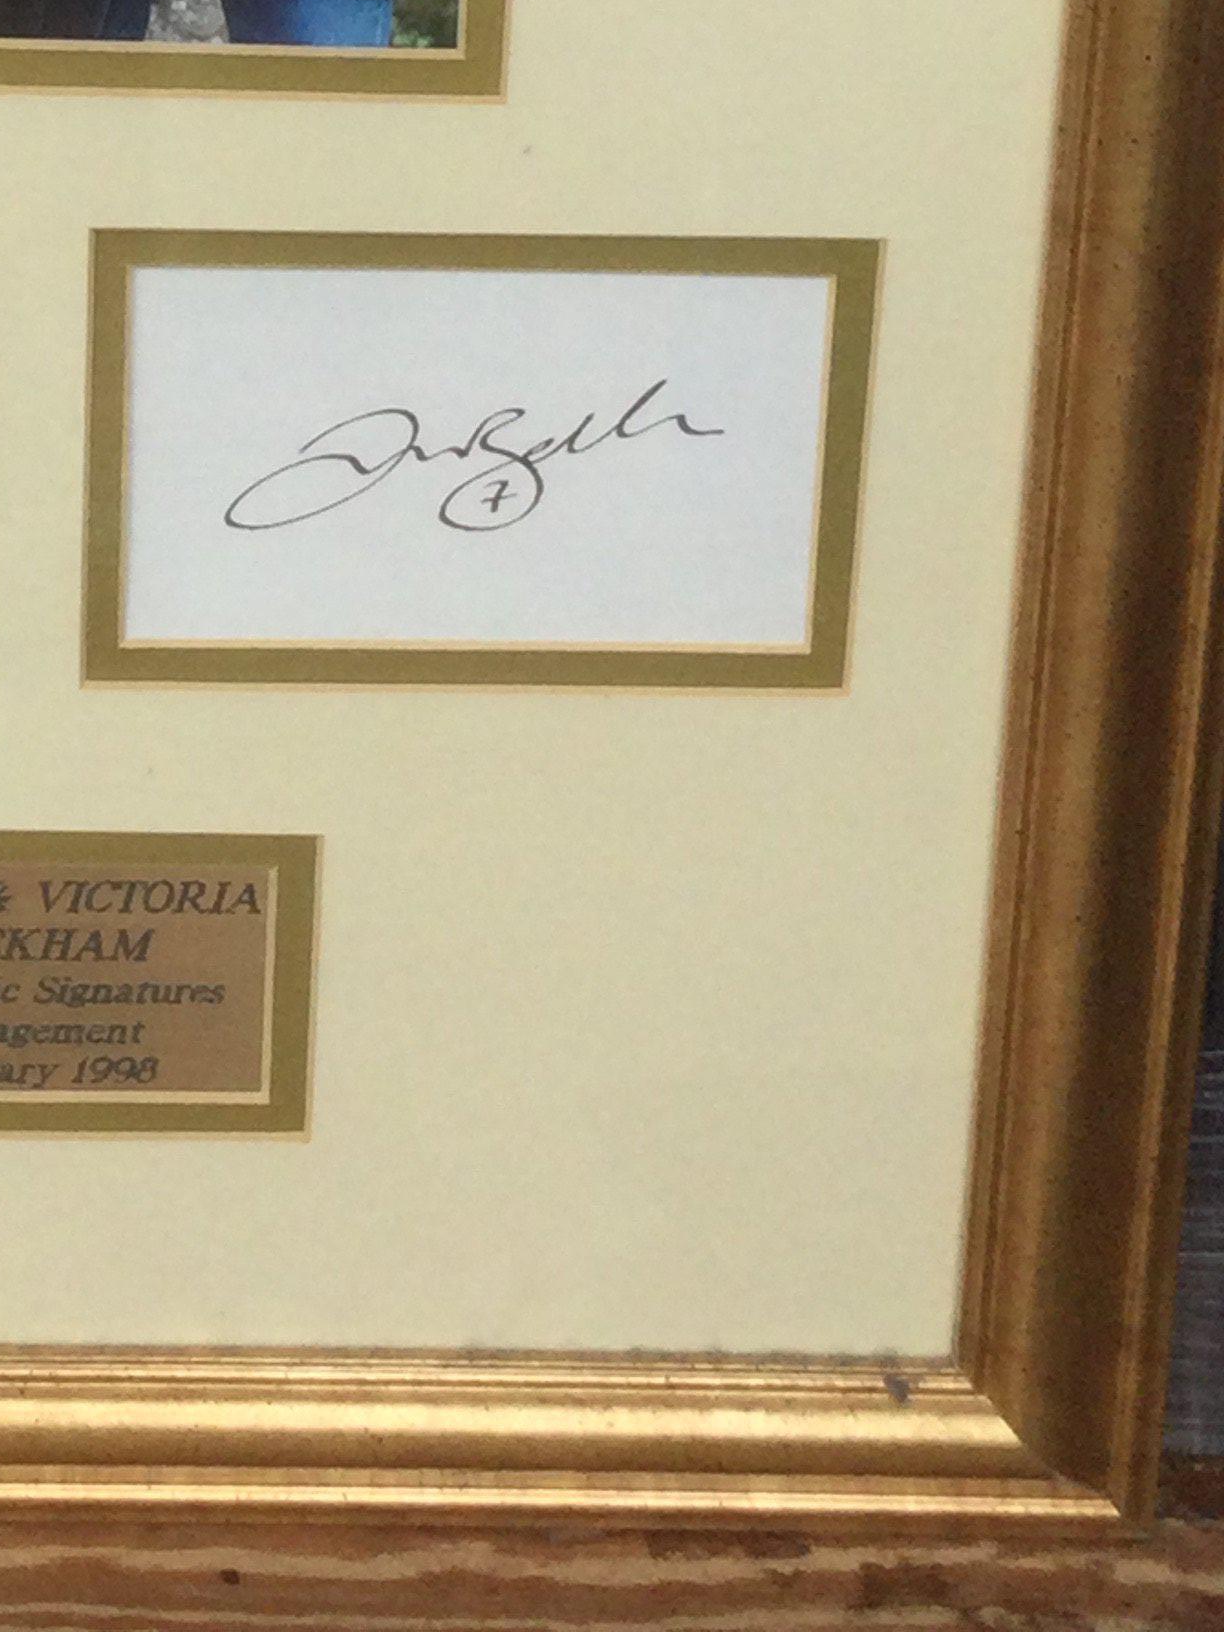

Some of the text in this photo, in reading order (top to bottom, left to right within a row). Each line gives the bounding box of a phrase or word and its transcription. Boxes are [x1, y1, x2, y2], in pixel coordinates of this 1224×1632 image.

[40, 879, 262, 915] VICTORIA
[33, 976, 225, 1007] Signatures
[71, 1057, 160, 1085] 1998
